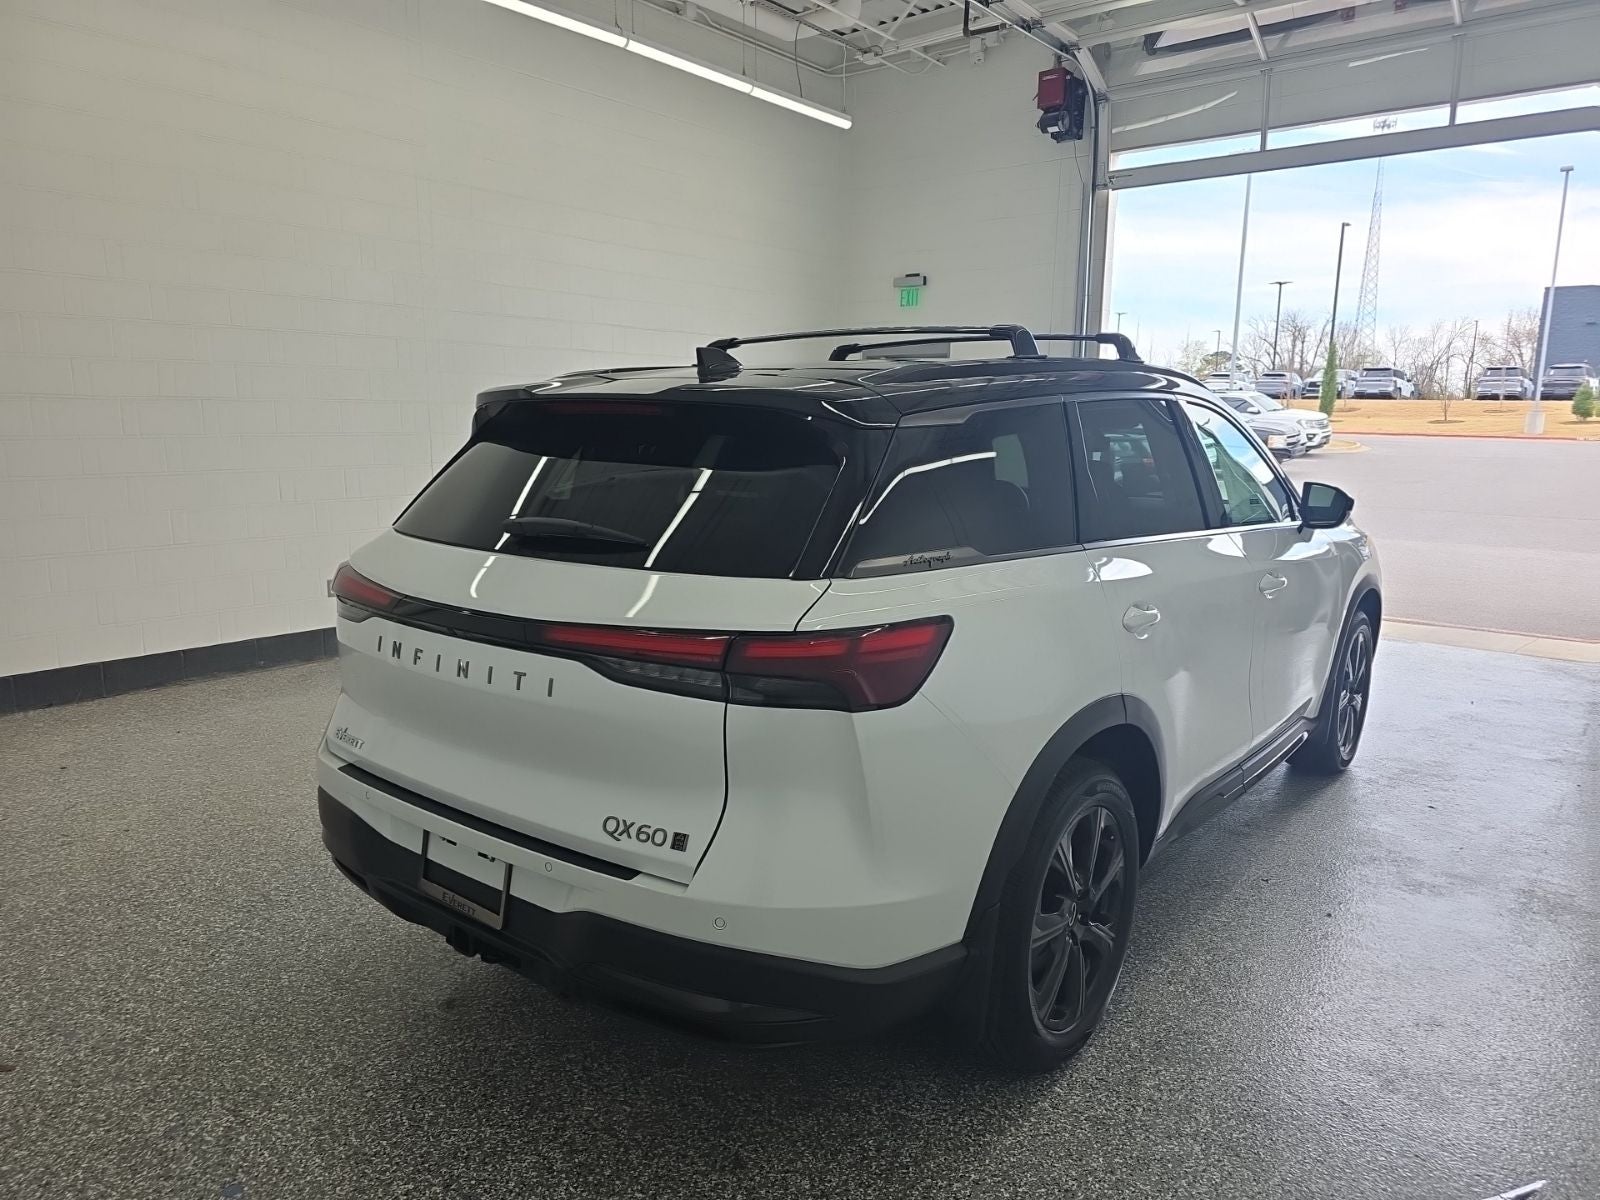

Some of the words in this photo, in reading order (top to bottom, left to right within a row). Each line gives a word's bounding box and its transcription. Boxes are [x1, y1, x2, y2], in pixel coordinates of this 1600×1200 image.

[900, 287, 920, 307] EXIT
[377, 635, 555, 698] INFINITI
[602, 815, 668, 848] QX60
[441, 891, 477, 917] EVERETT
